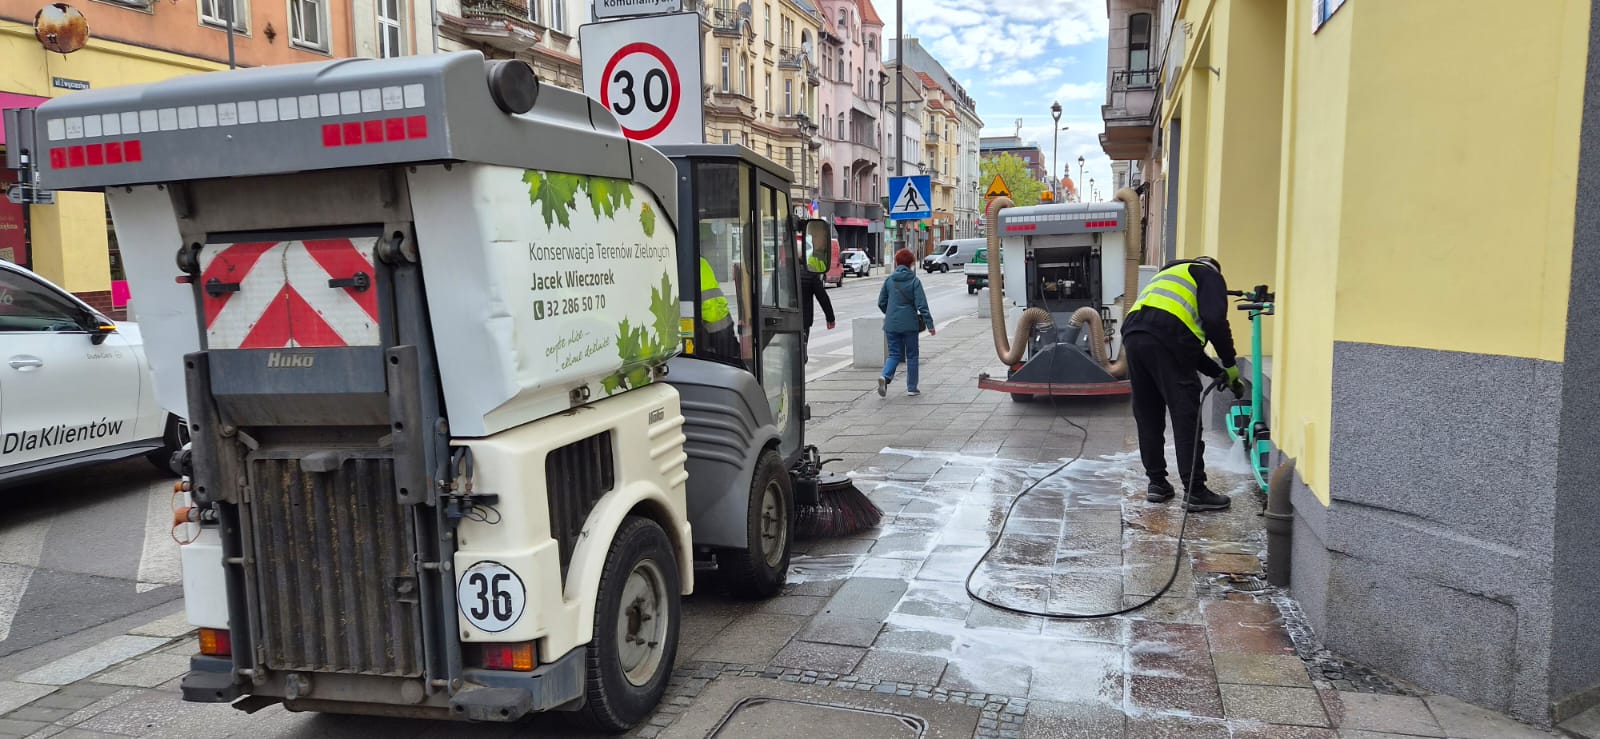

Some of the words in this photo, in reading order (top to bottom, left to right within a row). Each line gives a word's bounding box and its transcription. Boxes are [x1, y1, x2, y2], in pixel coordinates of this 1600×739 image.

[603, 0, 674, 8] komunany
[612, 68, 669, 116] 30
[528, 242, 594, 264] Konserwacja
[596, 241, 633, 260] Terenów
[634, 243, 670, 262] Zielonych
[531, 270, 563, 291] Jacek
[565, 268, 615, 287] Wieczorek
[547, 301, 559, 317] 32
[562, 298, 579, 315] 286
[582, 295, 593, 312] 50
[595, 294, 606, 310] 70
[3, 417, 123, 454] DlaKlientów
[469, 572, 512, 622] 36
